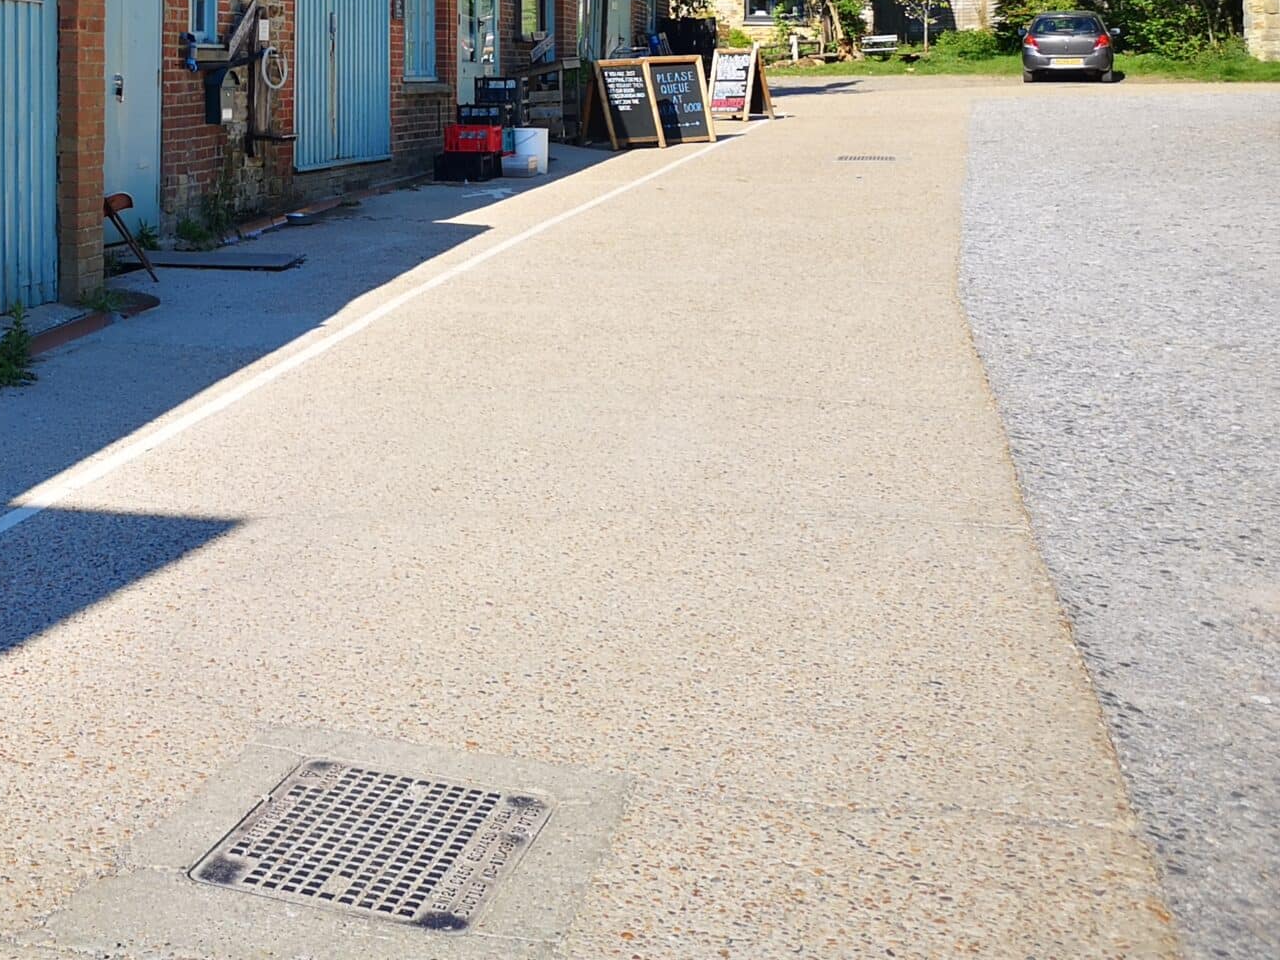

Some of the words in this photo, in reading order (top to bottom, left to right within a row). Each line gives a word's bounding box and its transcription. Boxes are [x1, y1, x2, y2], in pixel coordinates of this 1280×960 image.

[656, 71, 695, 83] PLEASE
[660, 82, 691, 94] QUEUE
[672, 95, 682, 104] AT
[683, 102, 702, 113] DOOR
